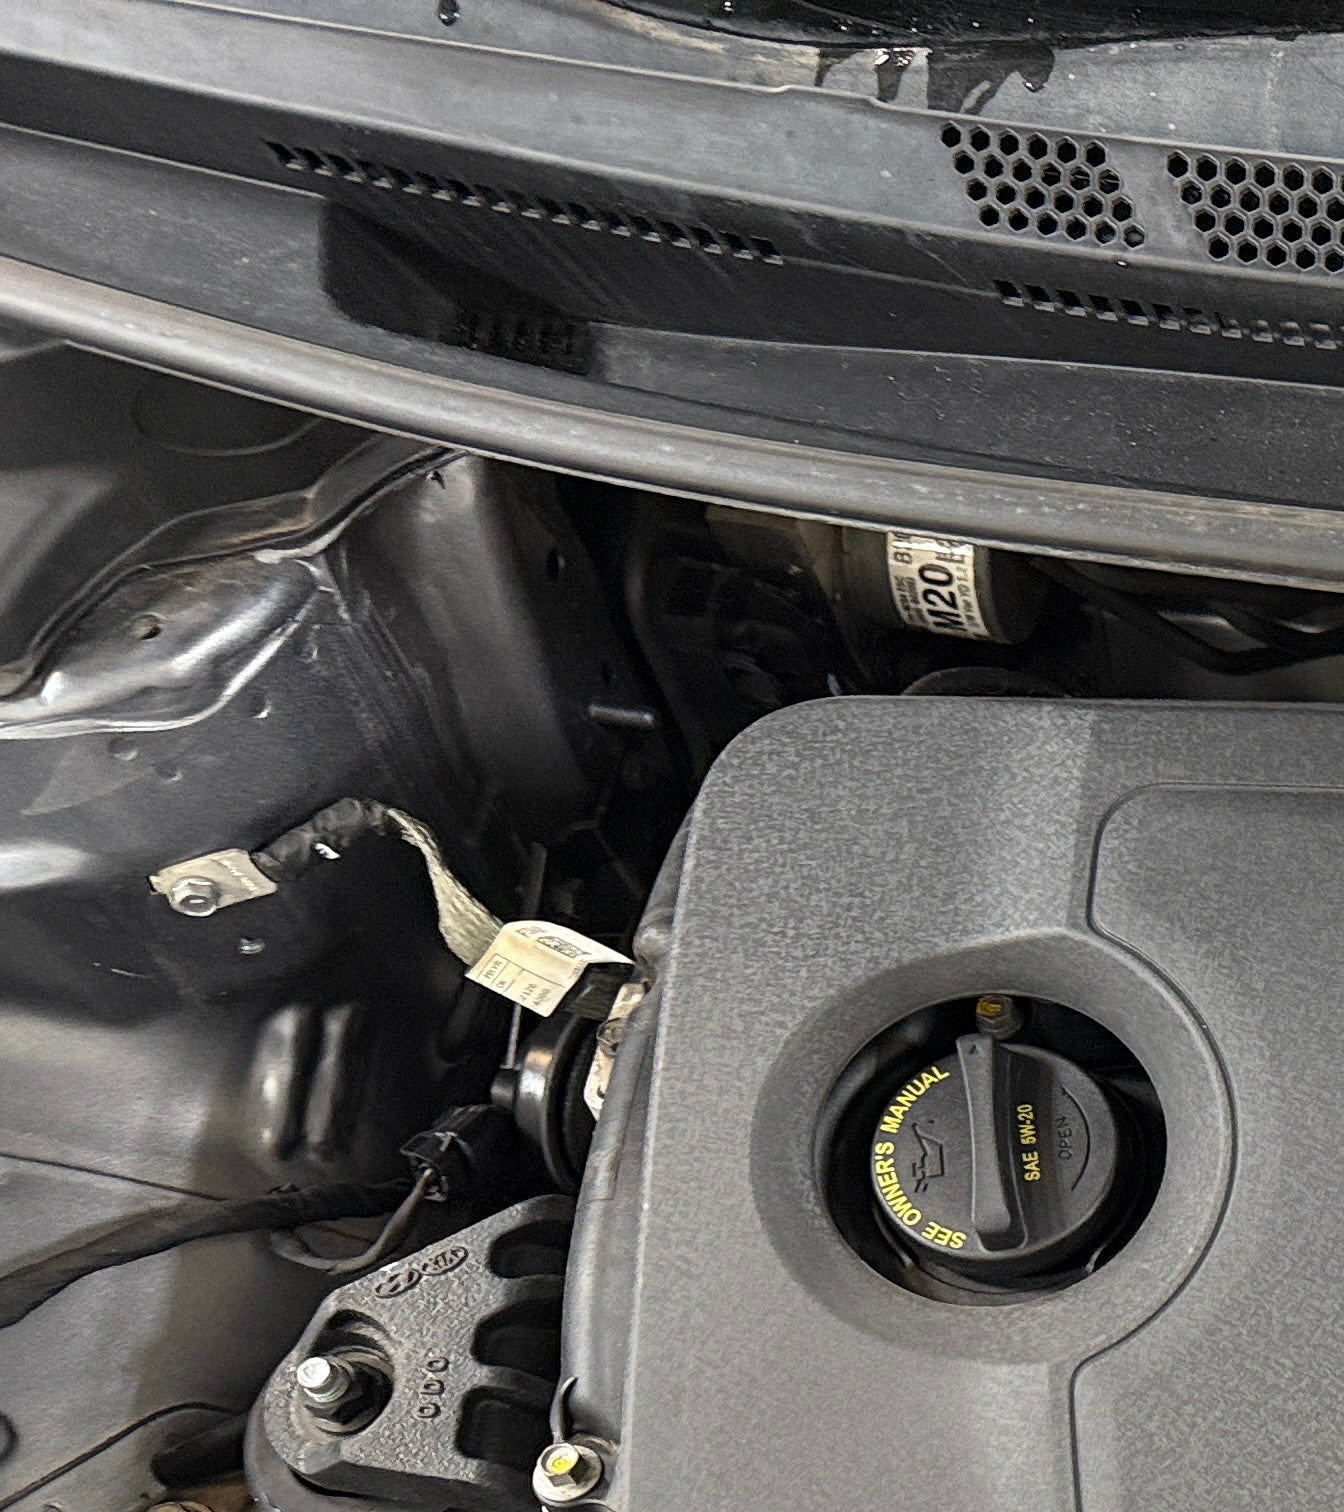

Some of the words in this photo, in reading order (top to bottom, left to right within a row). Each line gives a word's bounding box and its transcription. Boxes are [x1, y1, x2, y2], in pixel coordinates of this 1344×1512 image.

[879, 1064, 951, 1136] MANUAL
[1015, 1102, 1040, 1147] 5W-20
[1057, 1115, 1073, 1160] OPEN
[873, 1140, 923, 1227] OWNER'S
[1023, 1149, 1042, 1183] SAE
[921, 1220, 967, 1251] SEE
